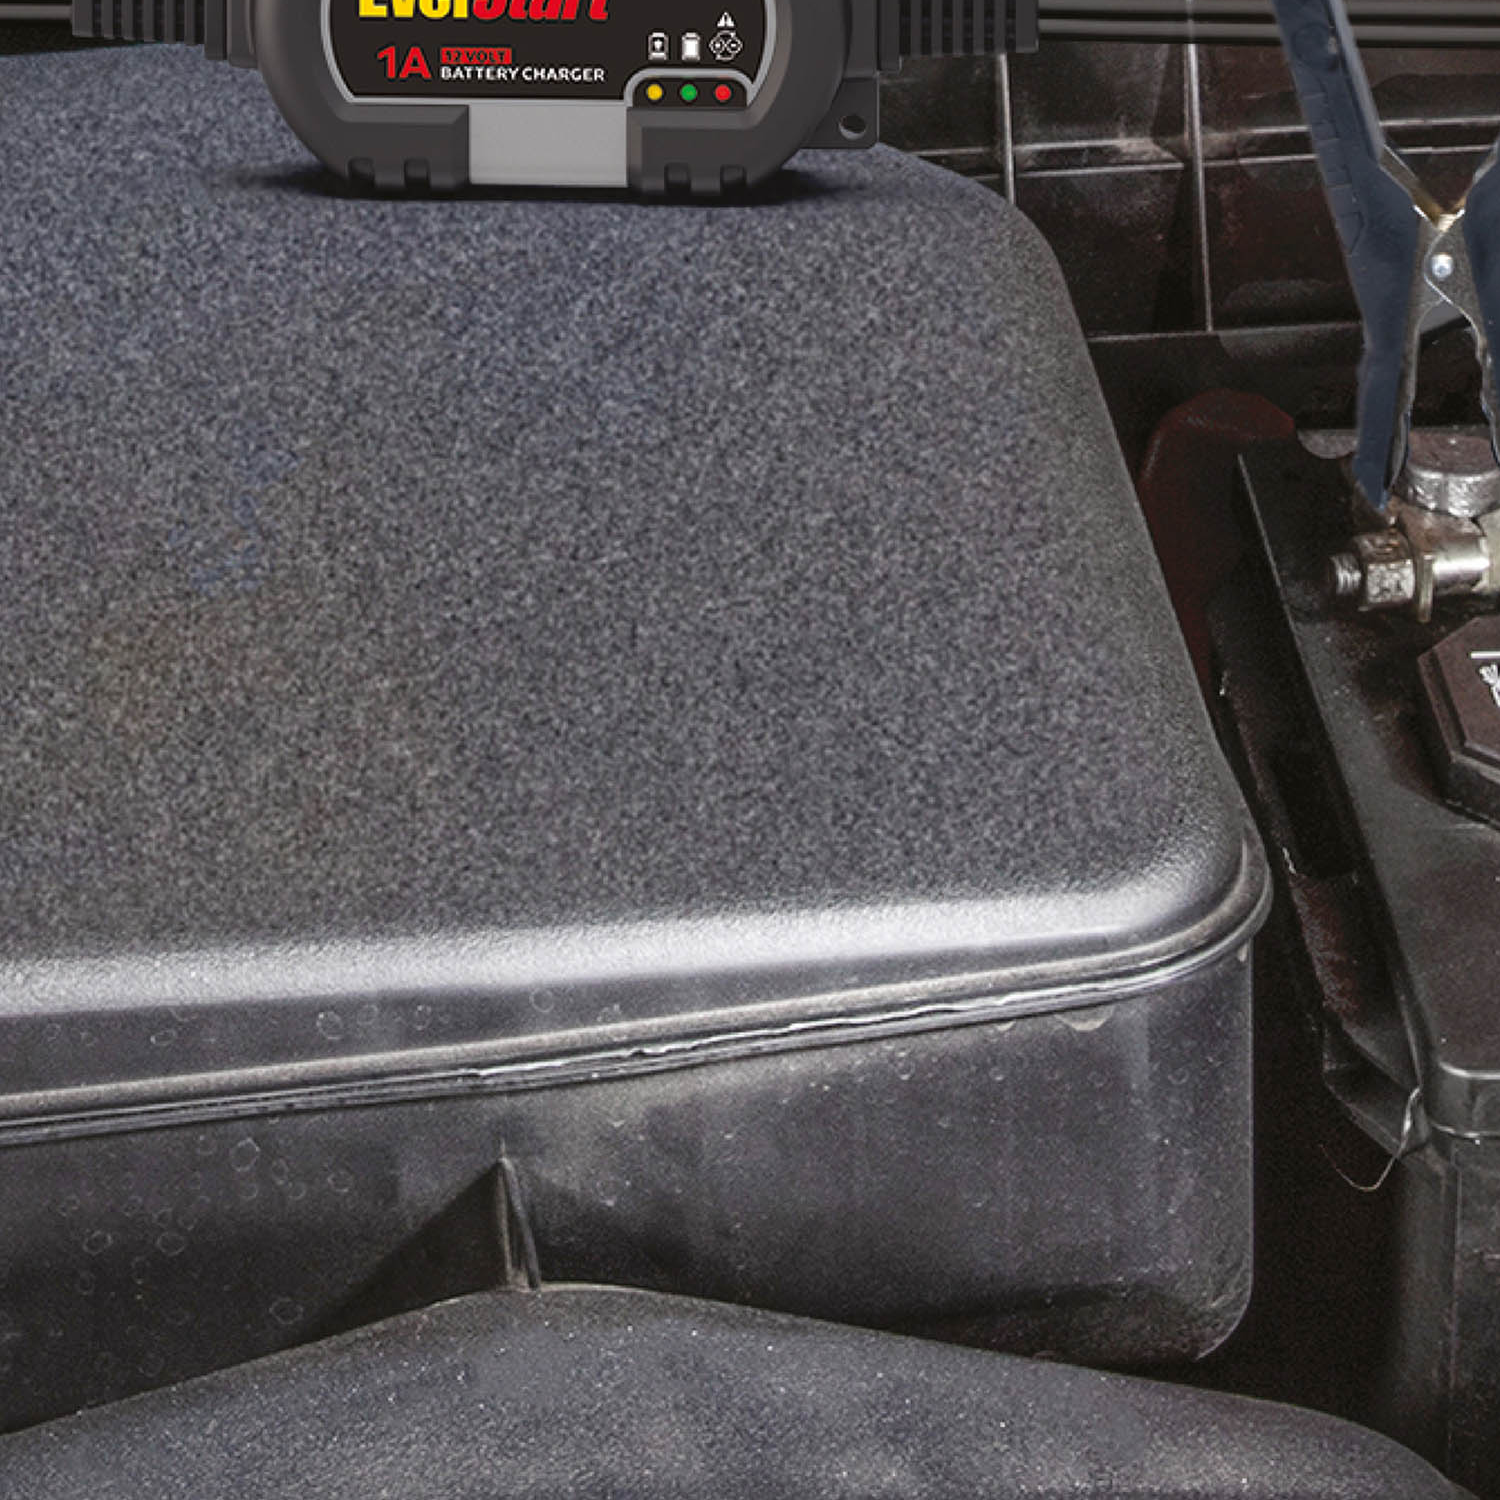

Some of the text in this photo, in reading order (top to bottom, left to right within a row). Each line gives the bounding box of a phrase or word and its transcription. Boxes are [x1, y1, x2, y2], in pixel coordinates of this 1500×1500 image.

[376, 46, 432, 79] 1A
[444, 50, 506, 62] 12 VOLT
[440, 66, 606, 82] BATTERY CHARGER
